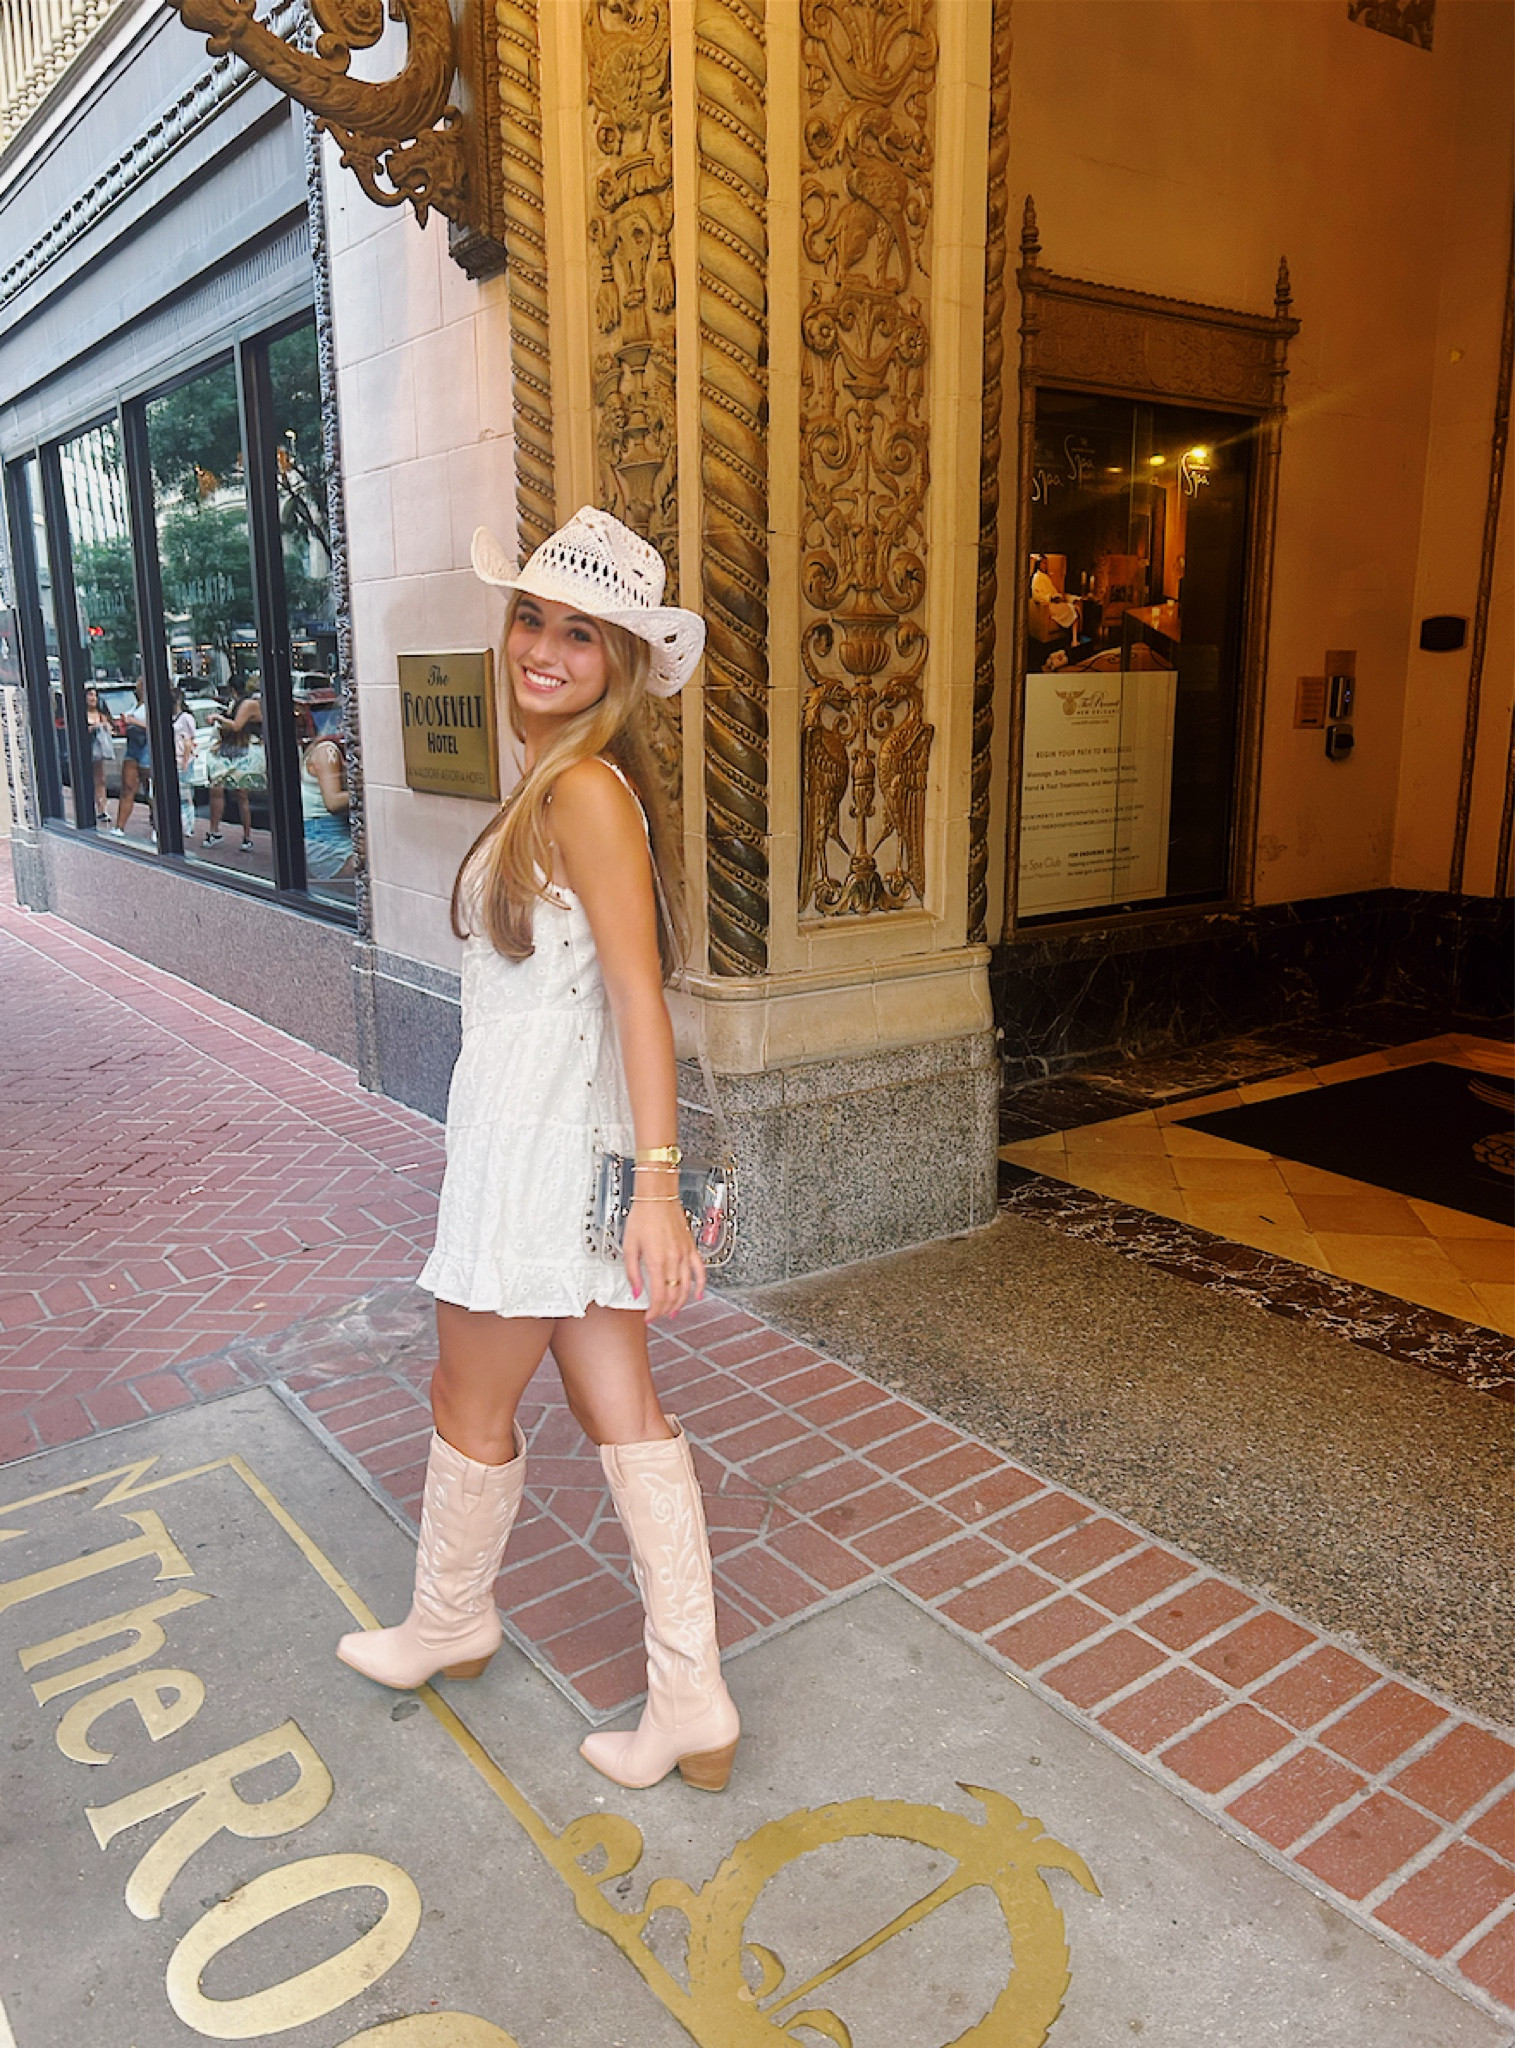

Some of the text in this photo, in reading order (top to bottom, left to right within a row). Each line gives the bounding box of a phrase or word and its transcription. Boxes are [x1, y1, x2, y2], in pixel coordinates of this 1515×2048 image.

[1180, 451, 1210, 499] Spa
[427, 665, 448, 686] The
[403, 691, 482, 728] ROOSEVELT
[427, 732, 459, 754] HOTEL
[1058, 749, 1076, 757] YOUR
[0, 1509, 521, 2048] The RO
